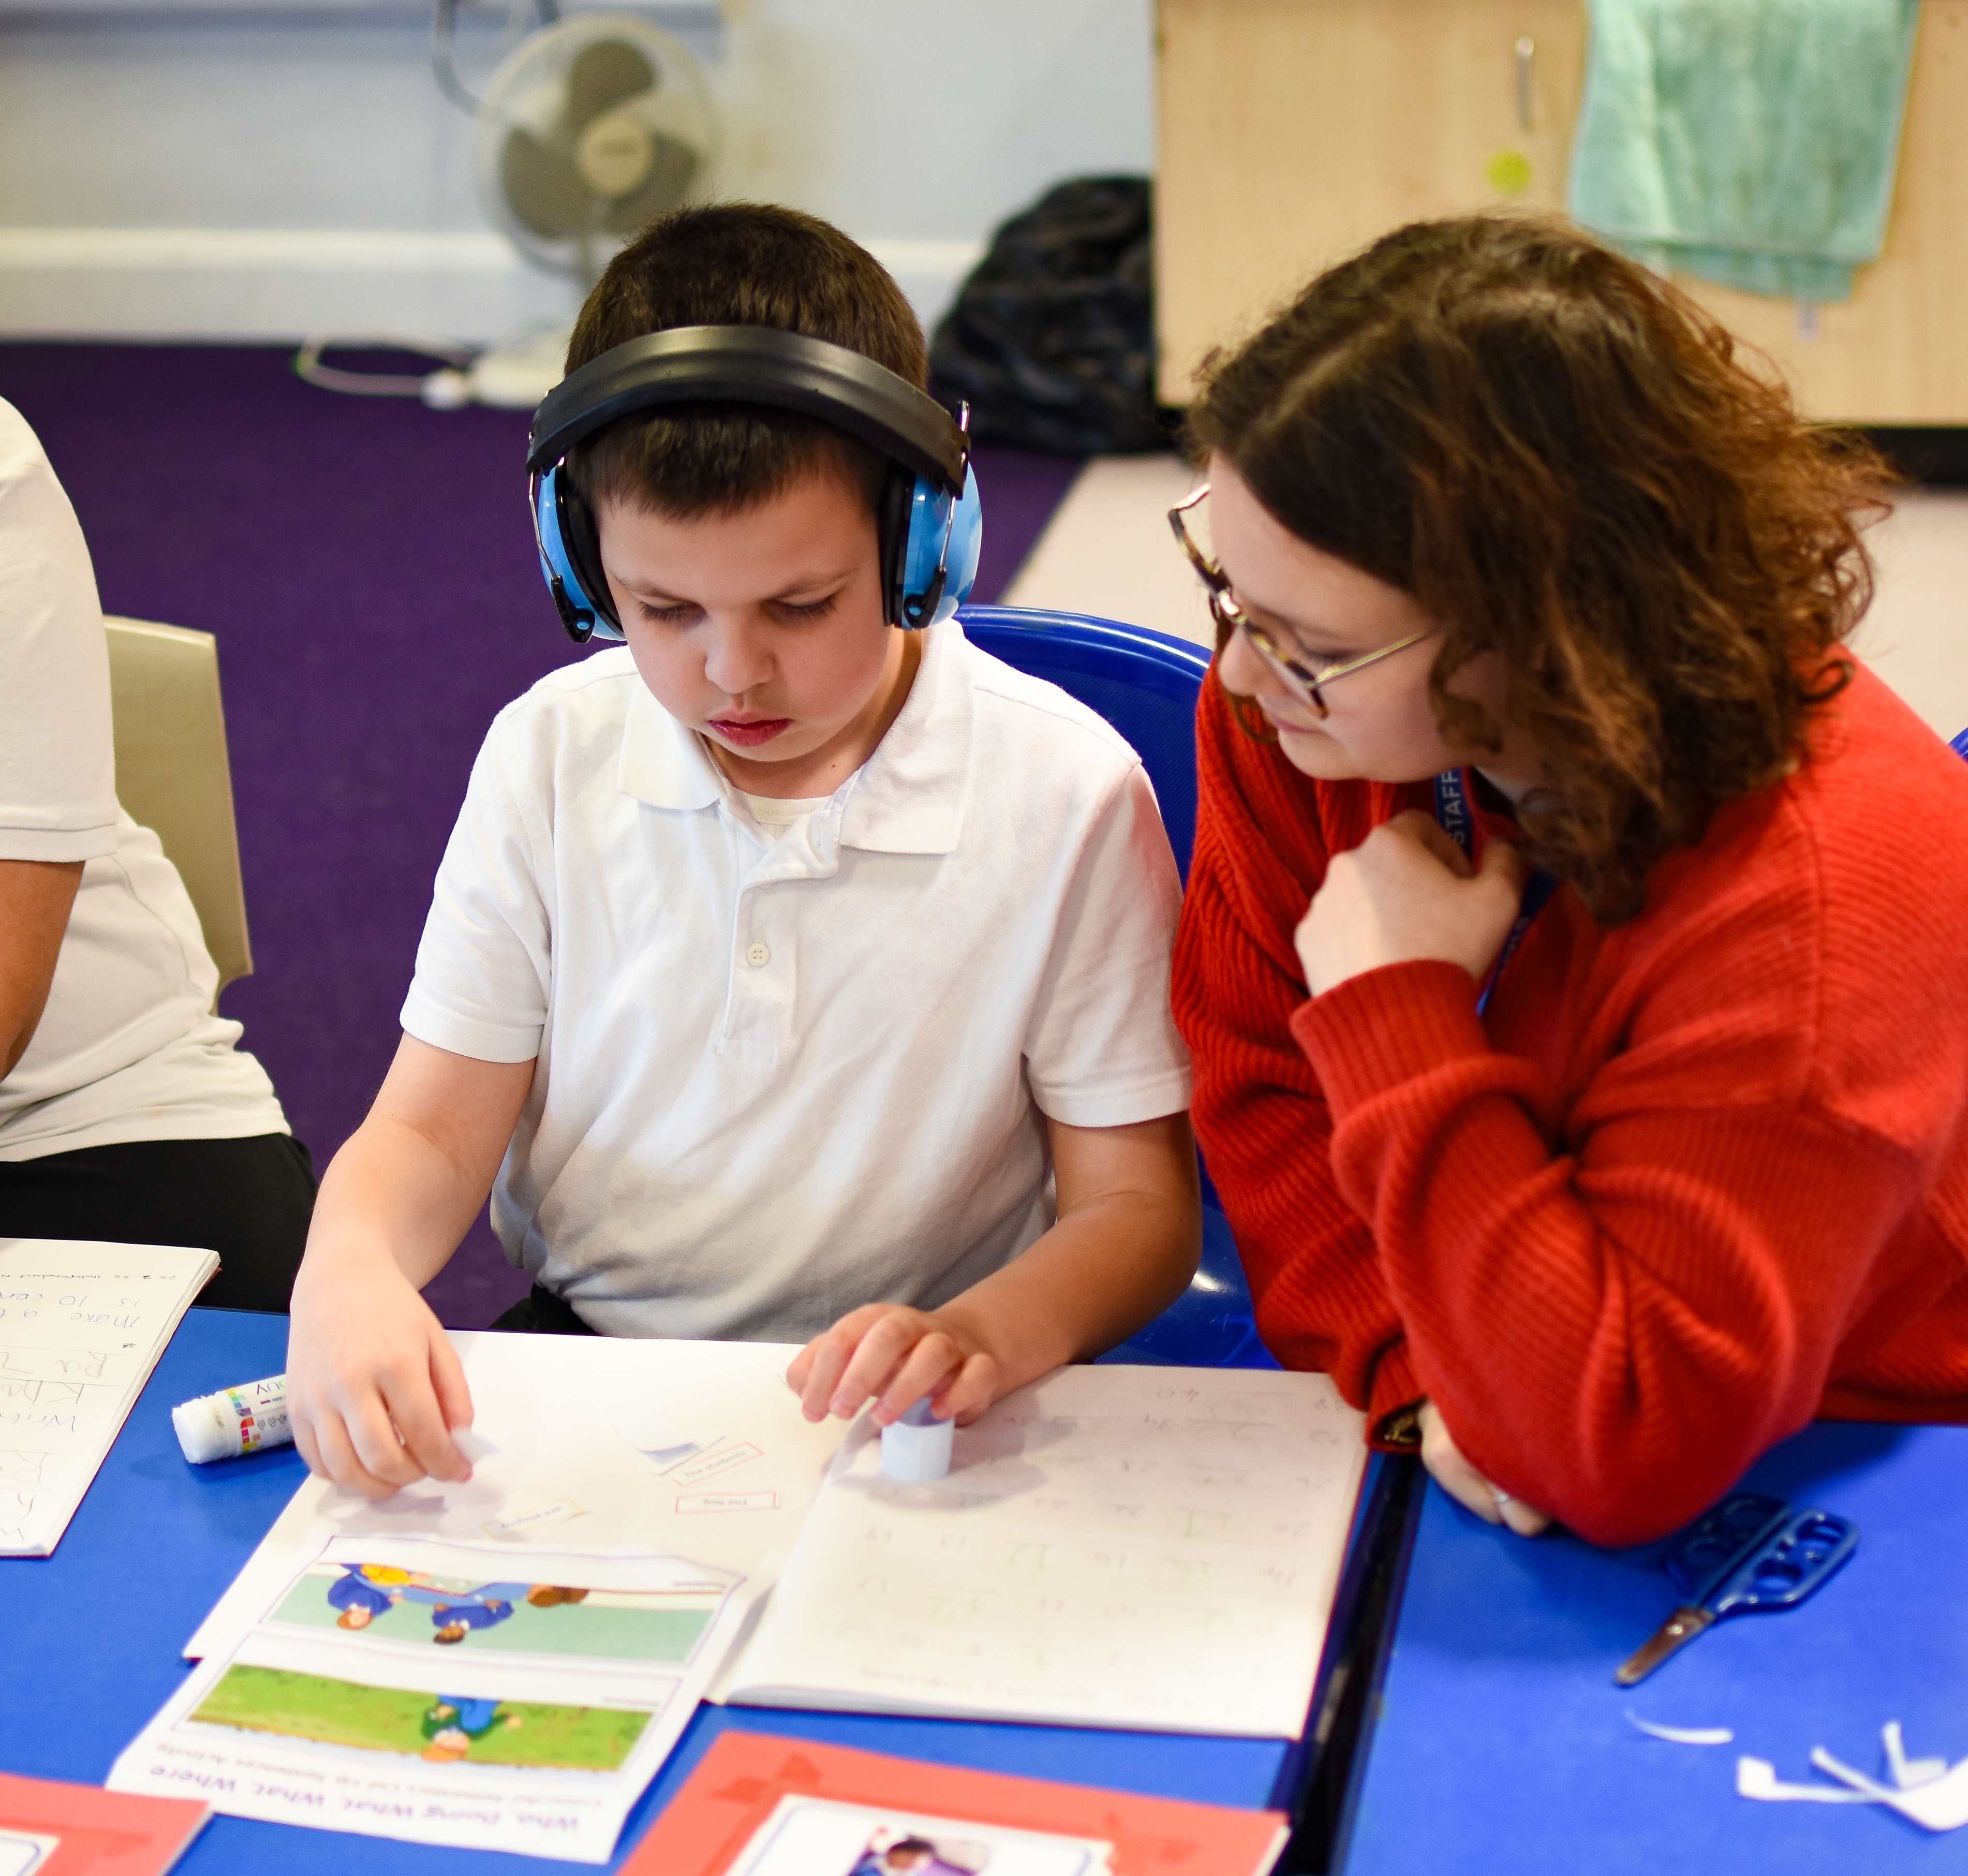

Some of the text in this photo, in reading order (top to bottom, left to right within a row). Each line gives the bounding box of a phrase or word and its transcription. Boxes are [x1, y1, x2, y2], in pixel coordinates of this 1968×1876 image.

[1441, 771, 1465, 844] STAFF
[59, 1295, 87, 1308] 10
[24, 1310, 37, 1319] a
[70, 1312, 139, 1328] Make
[0, 1413, 76, 1432] Writ
[150, 1765, 236, 1793] Where
[423, 1804, 501, 1826] Doing
